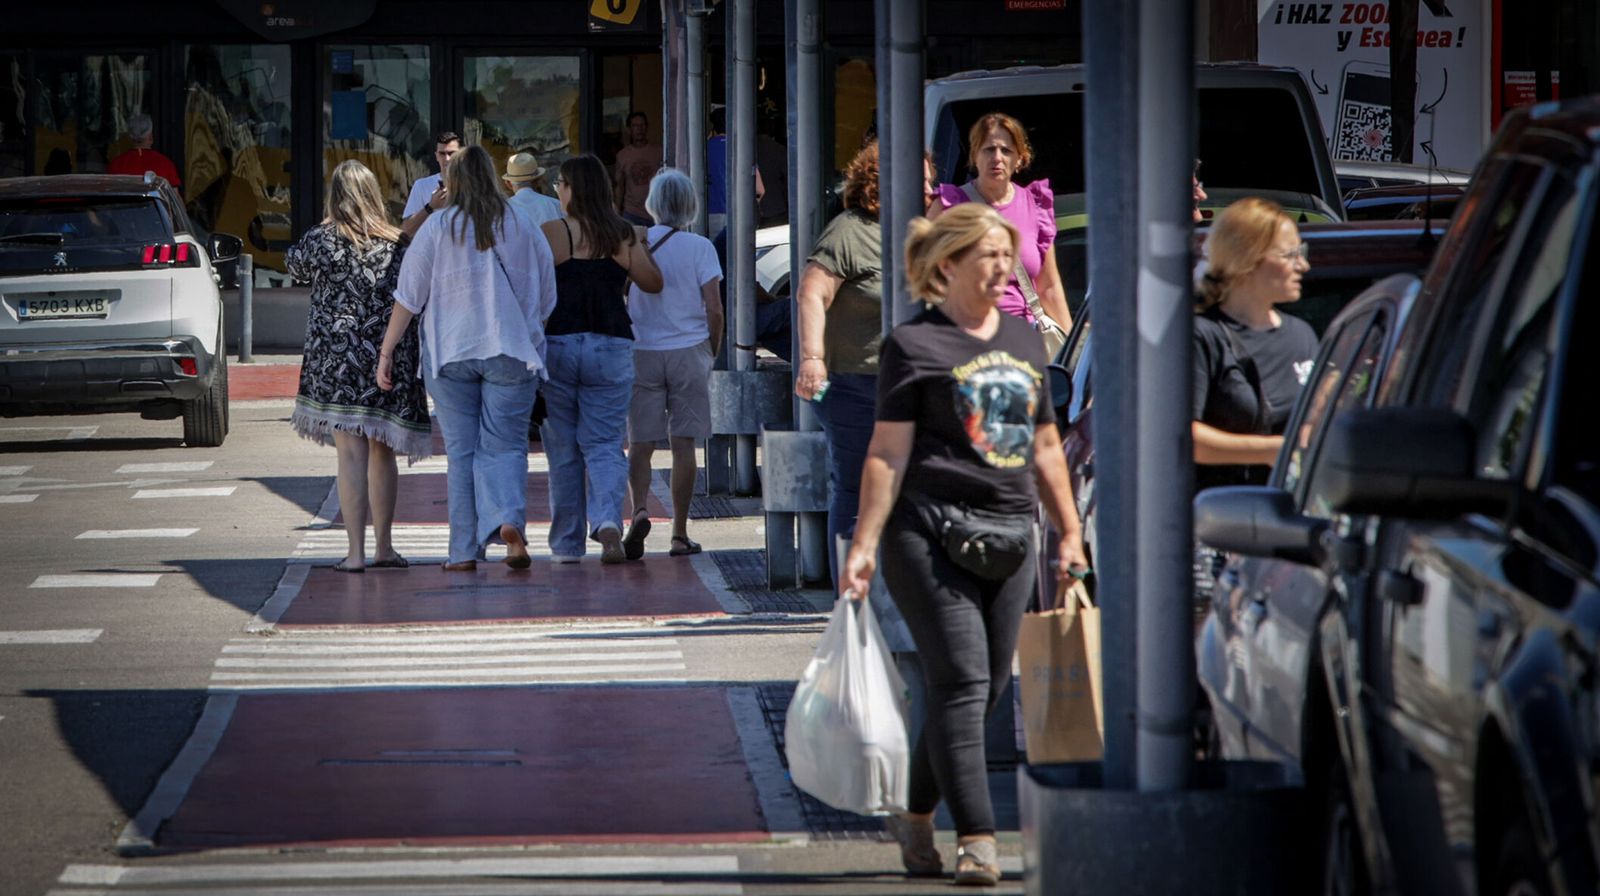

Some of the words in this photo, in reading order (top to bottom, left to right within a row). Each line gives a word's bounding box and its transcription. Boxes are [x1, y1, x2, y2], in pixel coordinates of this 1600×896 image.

[1336, 30, 1352, 51] y
[30, 300, 69, 314] 5703
[75, 298, 104, 313] KXB
